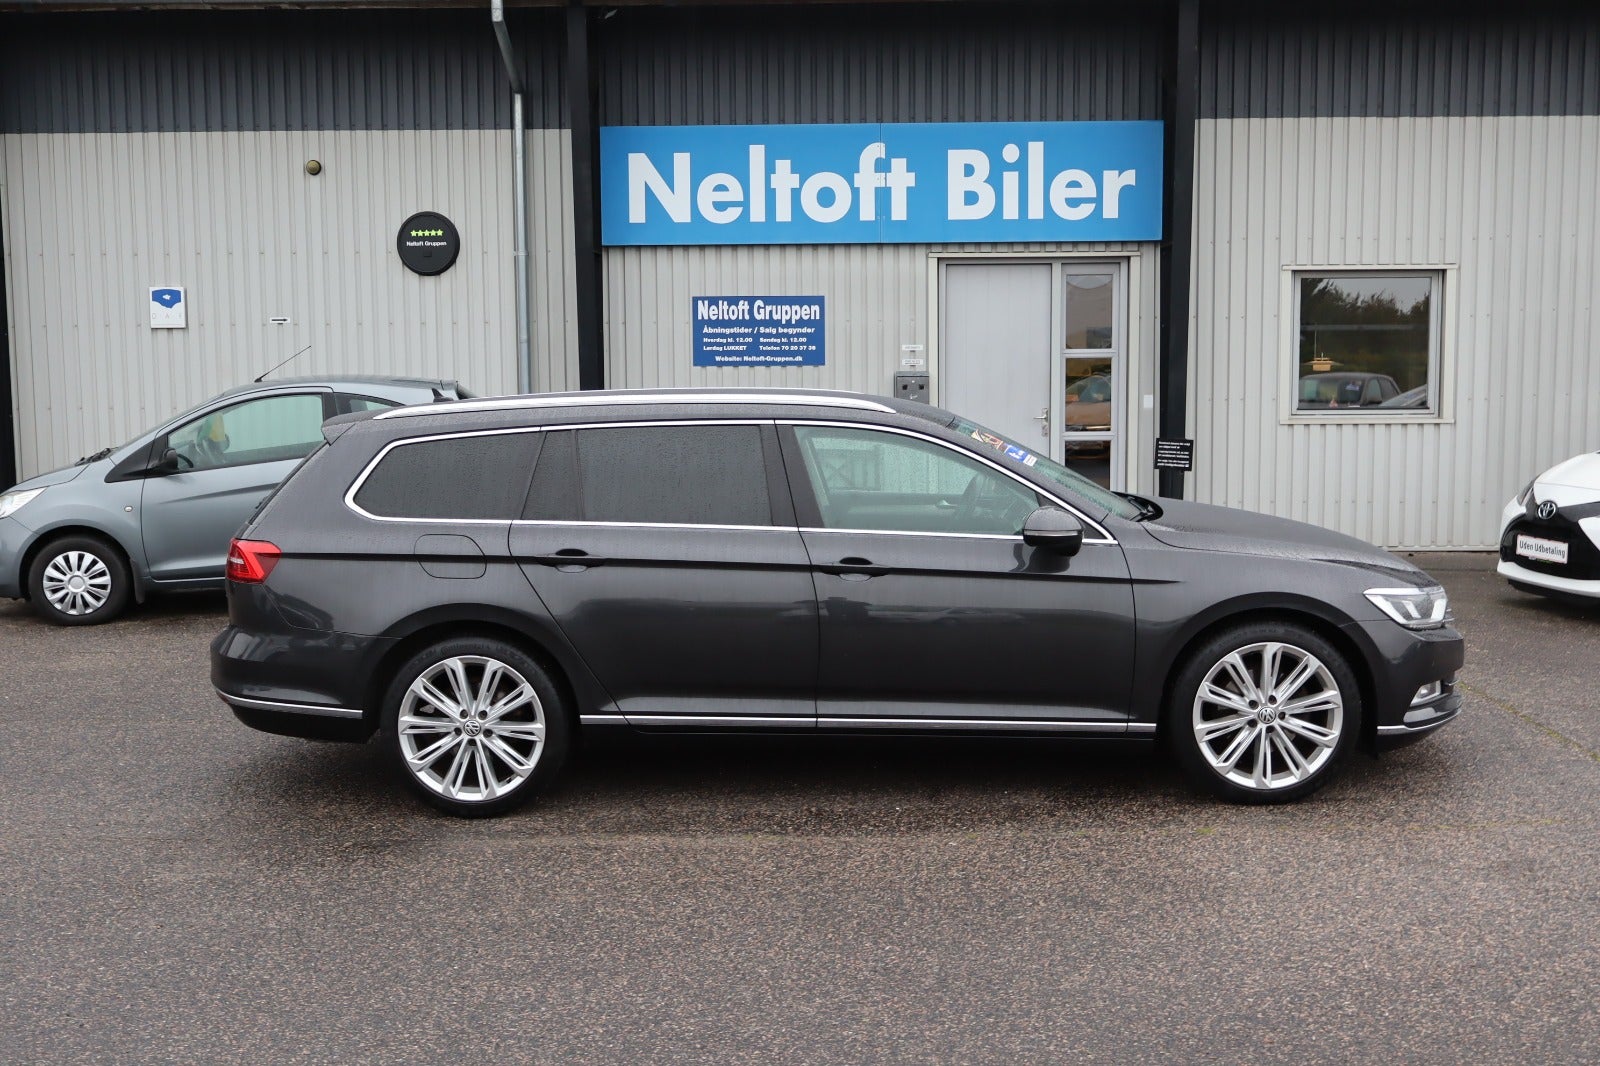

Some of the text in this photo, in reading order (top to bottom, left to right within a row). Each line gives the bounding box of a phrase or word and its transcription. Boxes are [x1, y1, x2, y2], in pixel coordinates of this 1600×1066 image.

[628, 141, 1136, 224] Neltoft Biler
[697, 299, 820, 324] Neltoft Gruppen
[703, 325, 752, 334] Åbningstider
[759, 326, 777, 334] Salg
[778, 326, 815, 334] begynder
[1519, 540, 1566, 559] Uden Udbetaling
